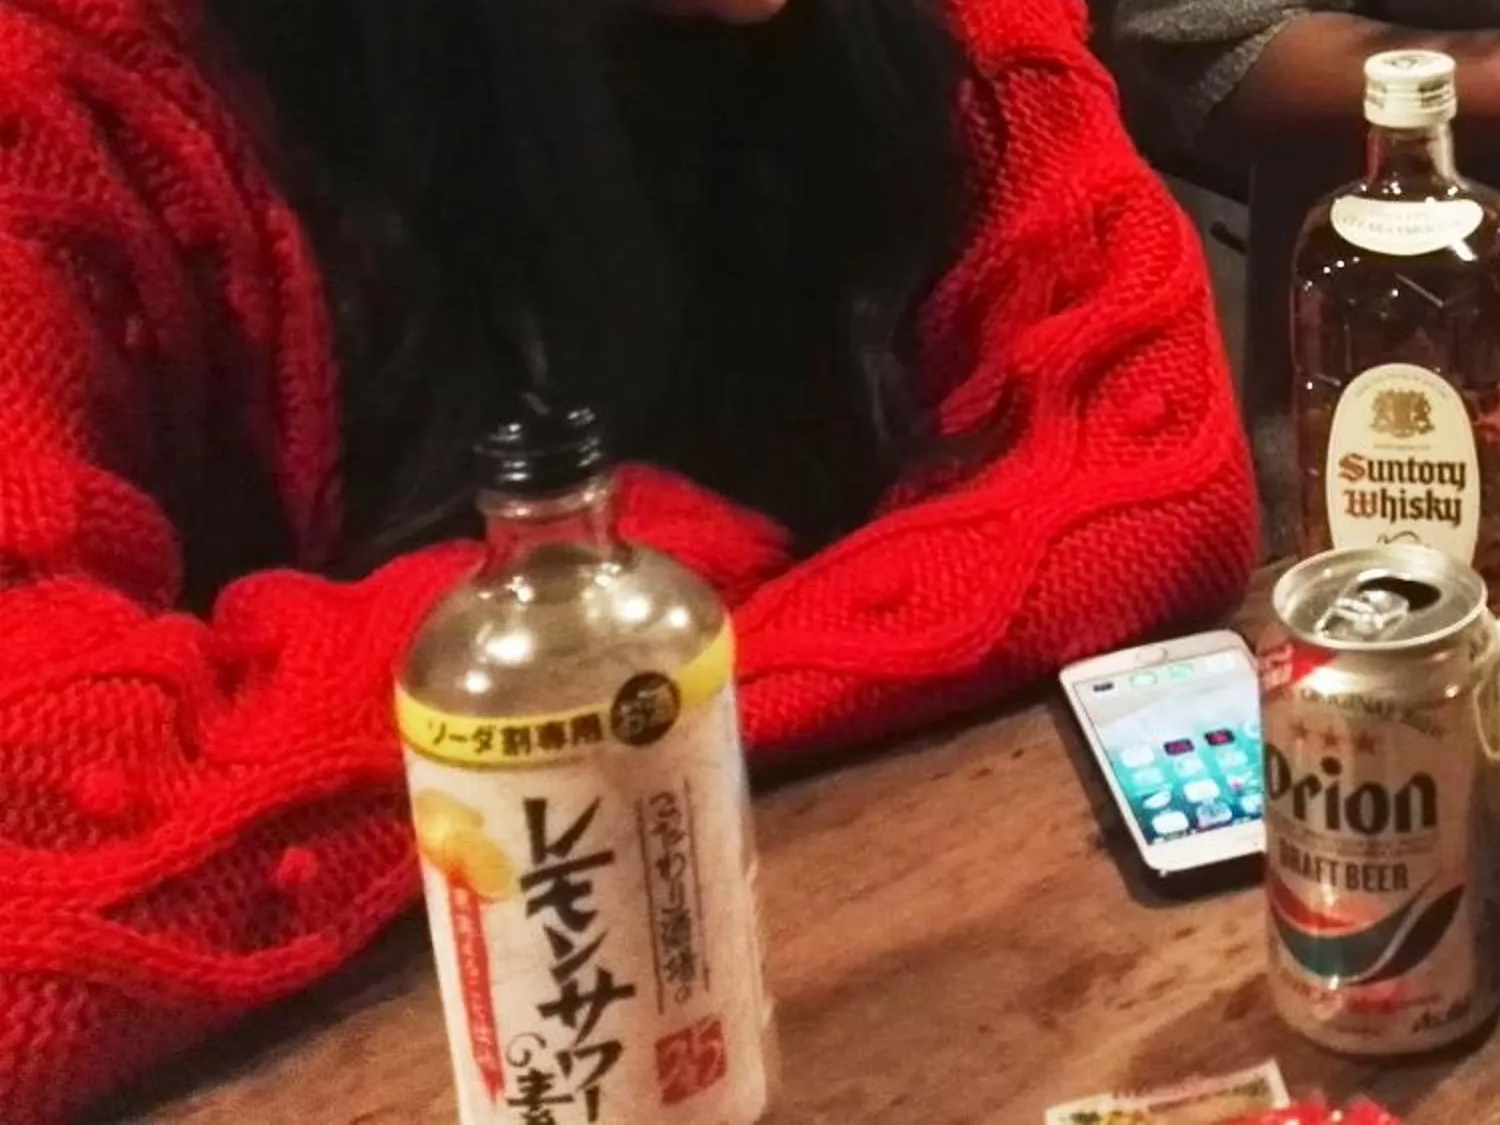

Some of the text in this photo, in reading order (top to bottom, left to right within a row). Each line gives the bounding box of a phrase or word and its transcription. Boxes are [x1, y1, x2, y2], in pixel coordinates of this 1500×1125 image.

[1338, 452, 1466, 491] Suntory
[1343, 487, 1462, 528] Whisky
[1345, 861, 1408, 893] BEER
[518, 795, 636, 1124] レモンサワー
